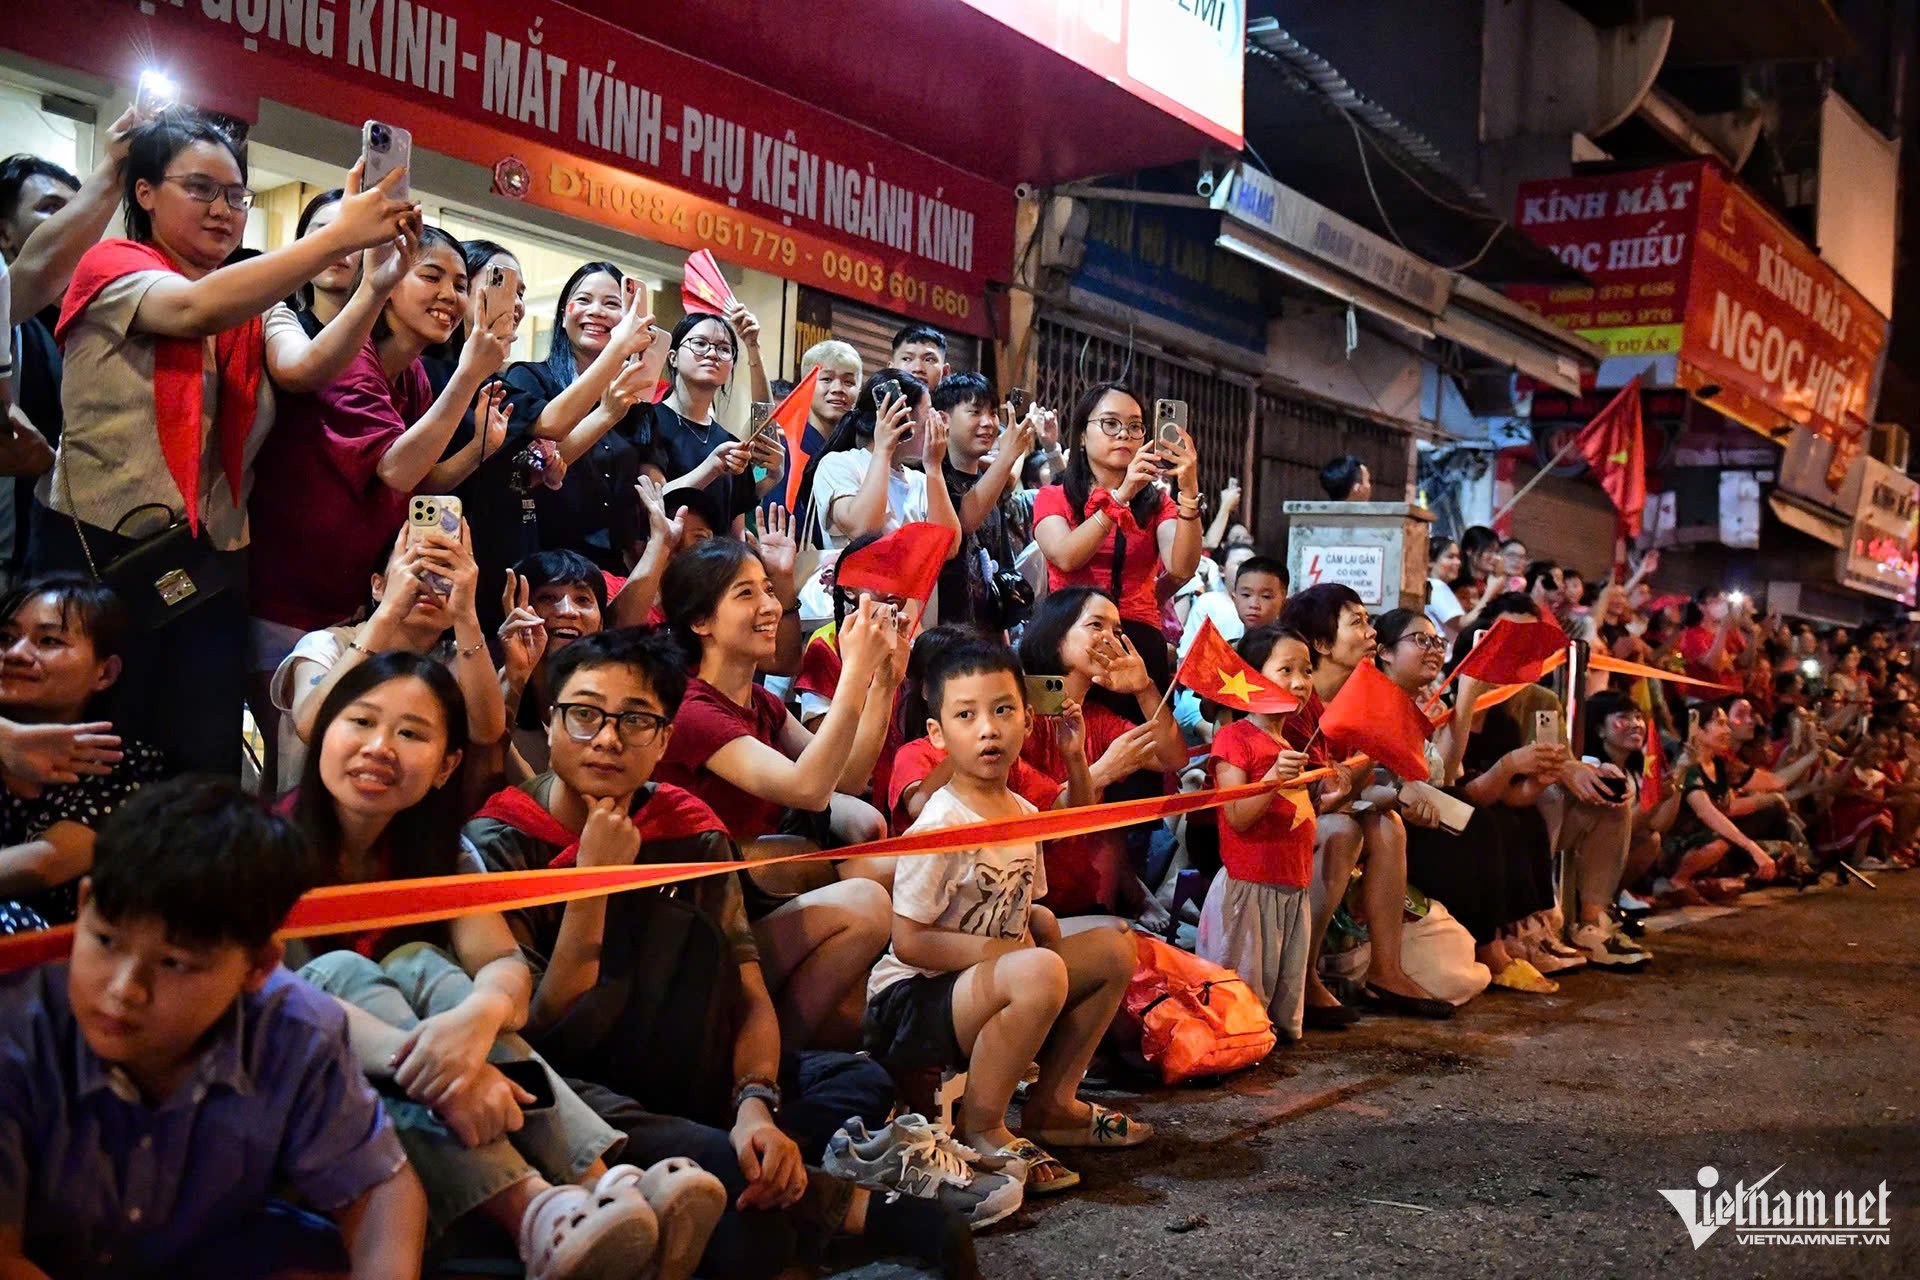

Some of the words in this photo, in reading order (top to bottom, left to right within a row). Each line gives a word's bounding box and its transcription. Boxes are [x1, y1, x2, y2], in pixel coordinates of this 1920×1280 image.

[751, 129, 819, 226] KIỆN
[823, 161, 914, 253] NGÀNH
[917, 187, 975, 273] KÍNH
[1521, 189, 1608, 225] KÍNH
[822, 250, 884, 292] 0903
[1605, 220, 1687, 271] HIẾU
[1757, 243, 1813, 315] KÍNH
